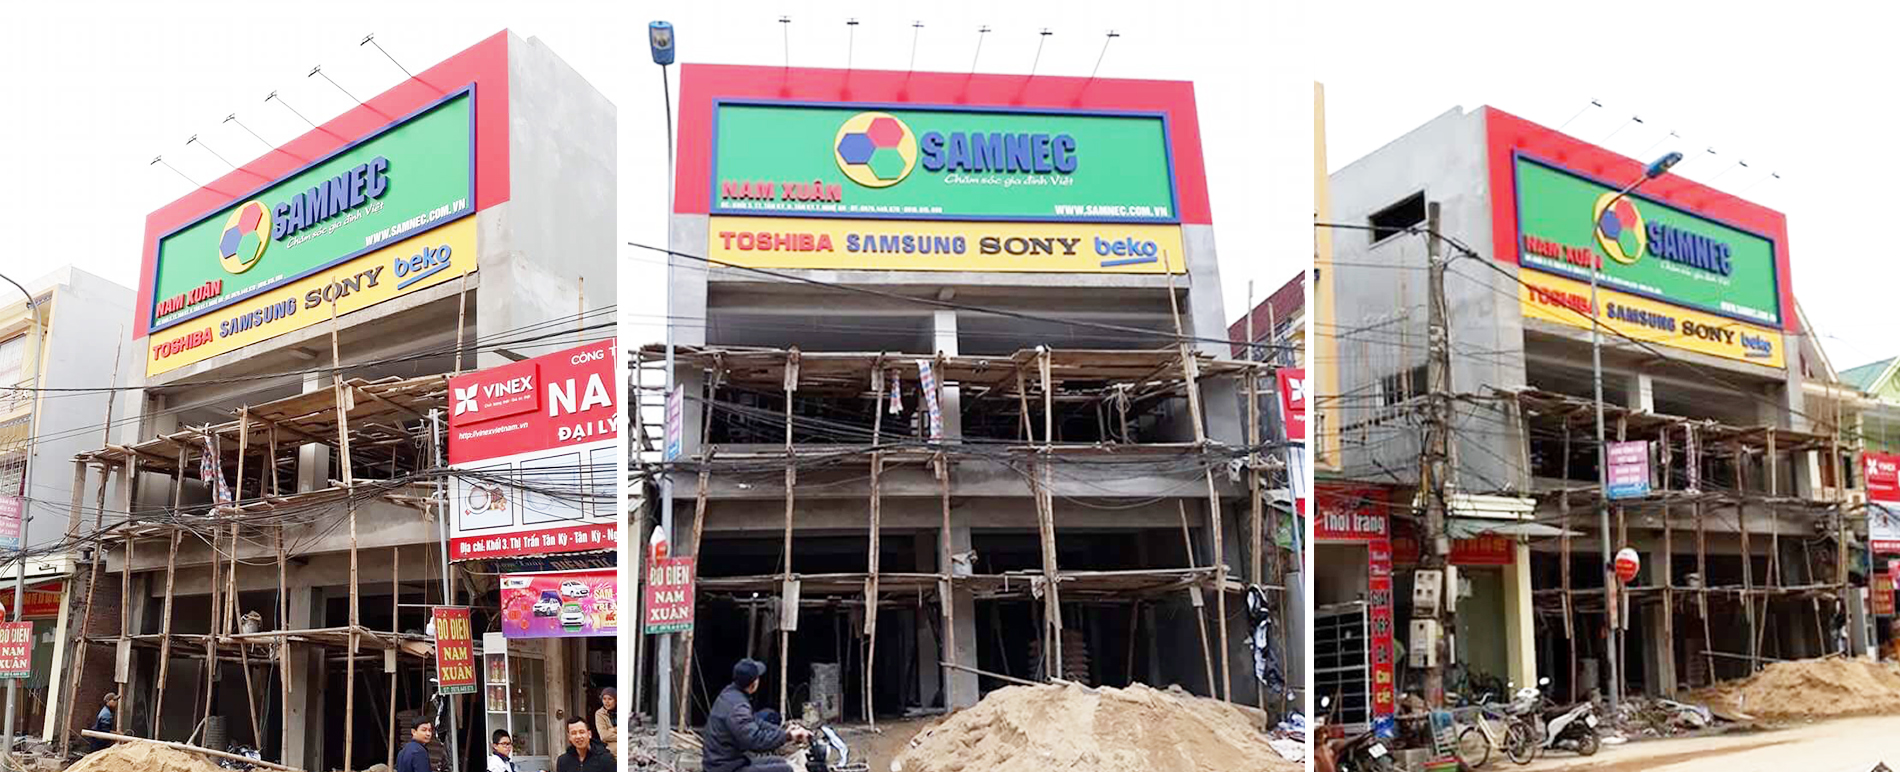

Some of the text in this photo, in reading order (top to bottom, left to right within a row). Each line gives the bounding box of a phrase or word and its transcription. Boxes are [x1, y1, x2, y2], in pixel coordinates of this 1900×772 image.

[921, 131, 1078, 174] SAMNEC
[271, 155, 390, 242] SAMNEC
[721, 181, 775, 200] NAM
[1055, 204, 1168, 217] WWW.SAMNEC.COM.VN
[719, 231, 1158, 256] TOSHIBA SAMSUNG SONY beko
[1647, 219, 1732, 277] SAMNEC
[152, 327, 213, 361] TOSHIBA
[219, 297, 297, 338] SAMSUNG
[304, 265, 384, 310] SONY
[394, 244, 452, 279] beko
[156, 293, 185, 318] NAM
[1606, 302, 1676, 332] SAMSUNG
[1682, 320, 1735, 345] SONY
[570, 349, 605, 366] CÔNG
[483, 375, 533, 399] VINEX
[558, 421, 593, 442] ĐẠI
[655, 590, 685, 604] NAM
[2, 646, 25, 657] NAM
[443, 646, 468, 661] NAM
